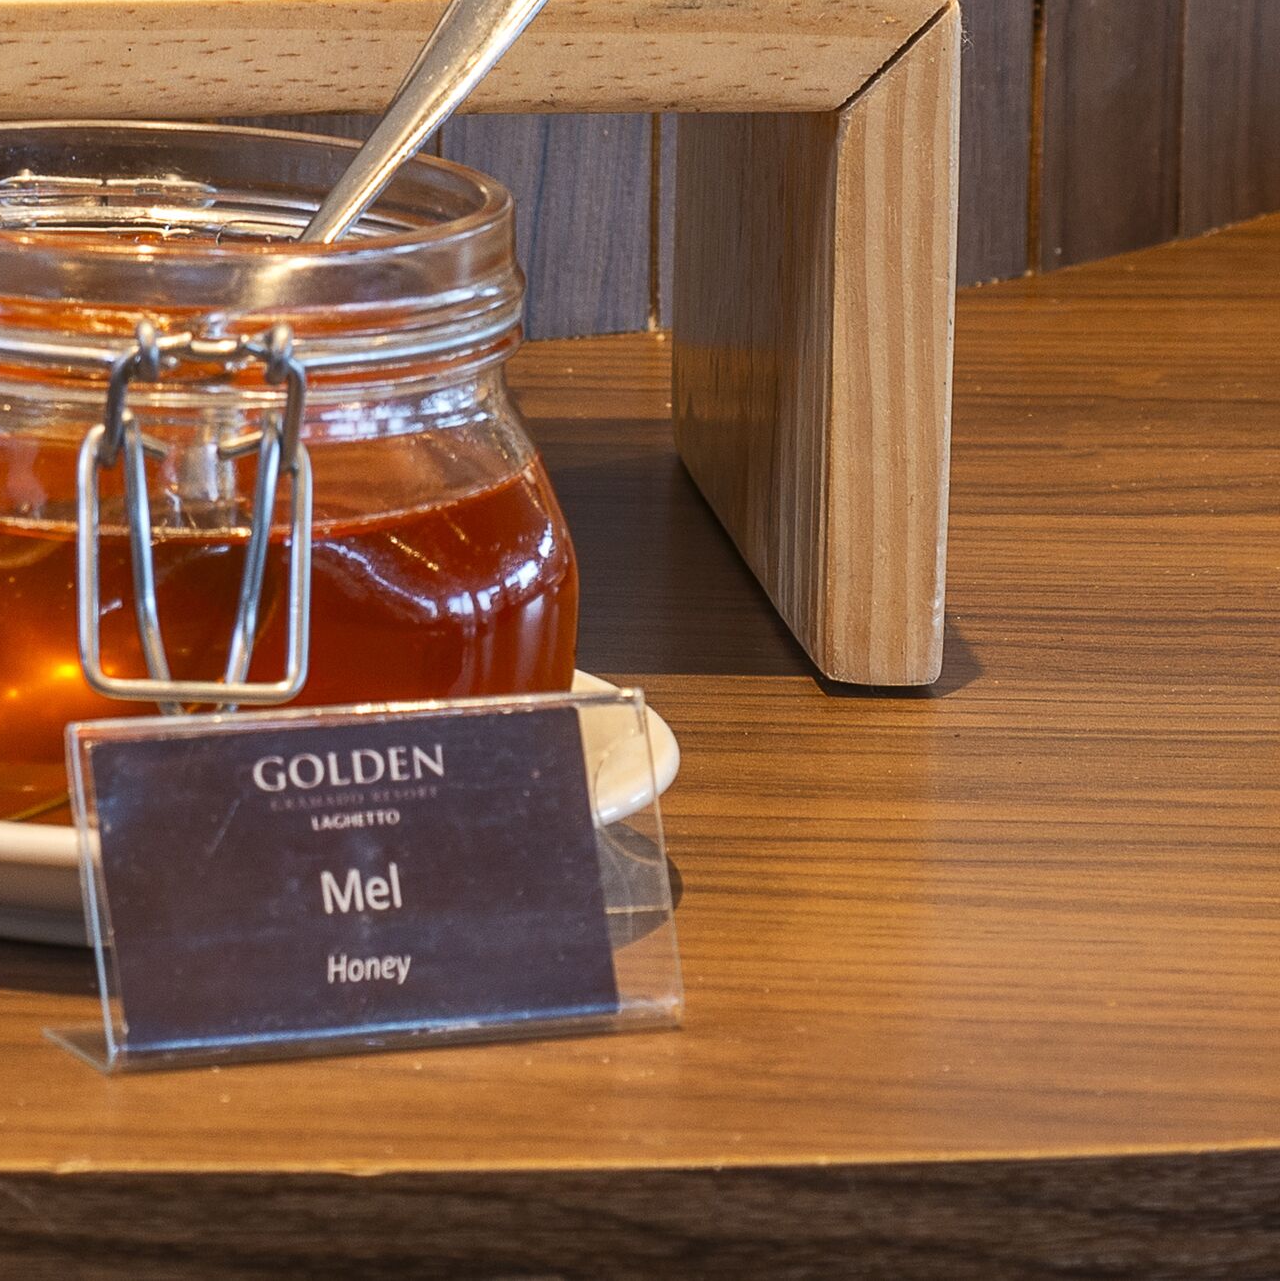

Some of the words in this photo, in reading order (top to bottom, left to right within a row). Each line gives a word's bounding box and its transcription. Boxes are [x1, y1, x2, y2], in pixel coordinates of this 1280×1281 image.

[252, 743, 446, 793] GOLDEN
[320, 861, 403, 915] Mel
[327, 952, 413, 986] Honey
